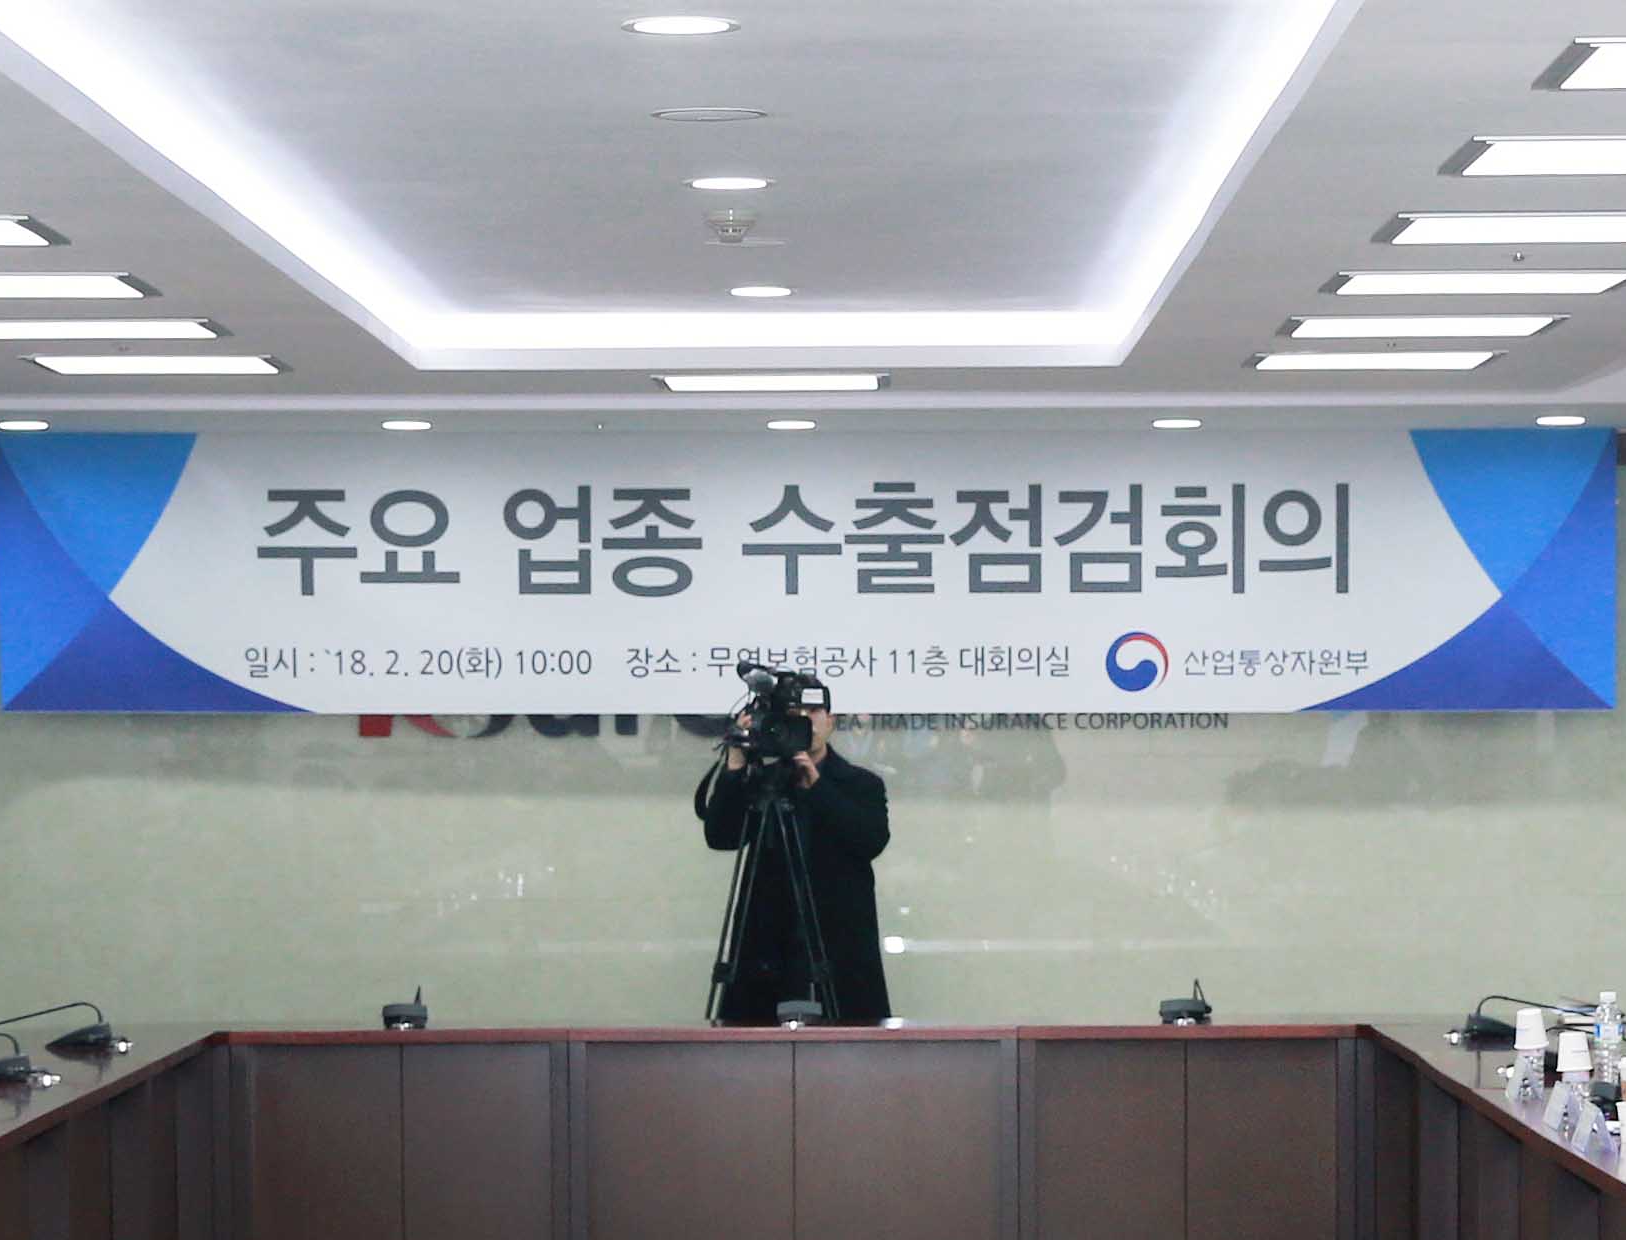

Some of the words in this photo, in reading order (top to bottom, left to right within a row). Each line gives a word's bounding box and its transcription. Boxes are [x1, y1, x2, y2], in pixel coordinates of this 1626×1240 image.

[257, 488, 461, 596] 주요
[503, 484, 703, 598] 업종
[741, 481, 1350, 595] 수출점검회의
[244, 646, 298, 679] 일시
[384, 649, 410, 677] 2.
[419, 646, 503, 680] 20(화)
[516, 649, 593, 676] 10:00
[625, 647, 681, 678] 장소
[889, 645, 950, 678] 11층
[958, 645, 1070, 678] 대회의실
[1183, 649, 1369, 677] 산업통상자원부
[869, 713, 938, 731] TRADE
[944, 713, 1070, 731] INSURANCE
[1073, 712, 1230, 730] CORPORATION
